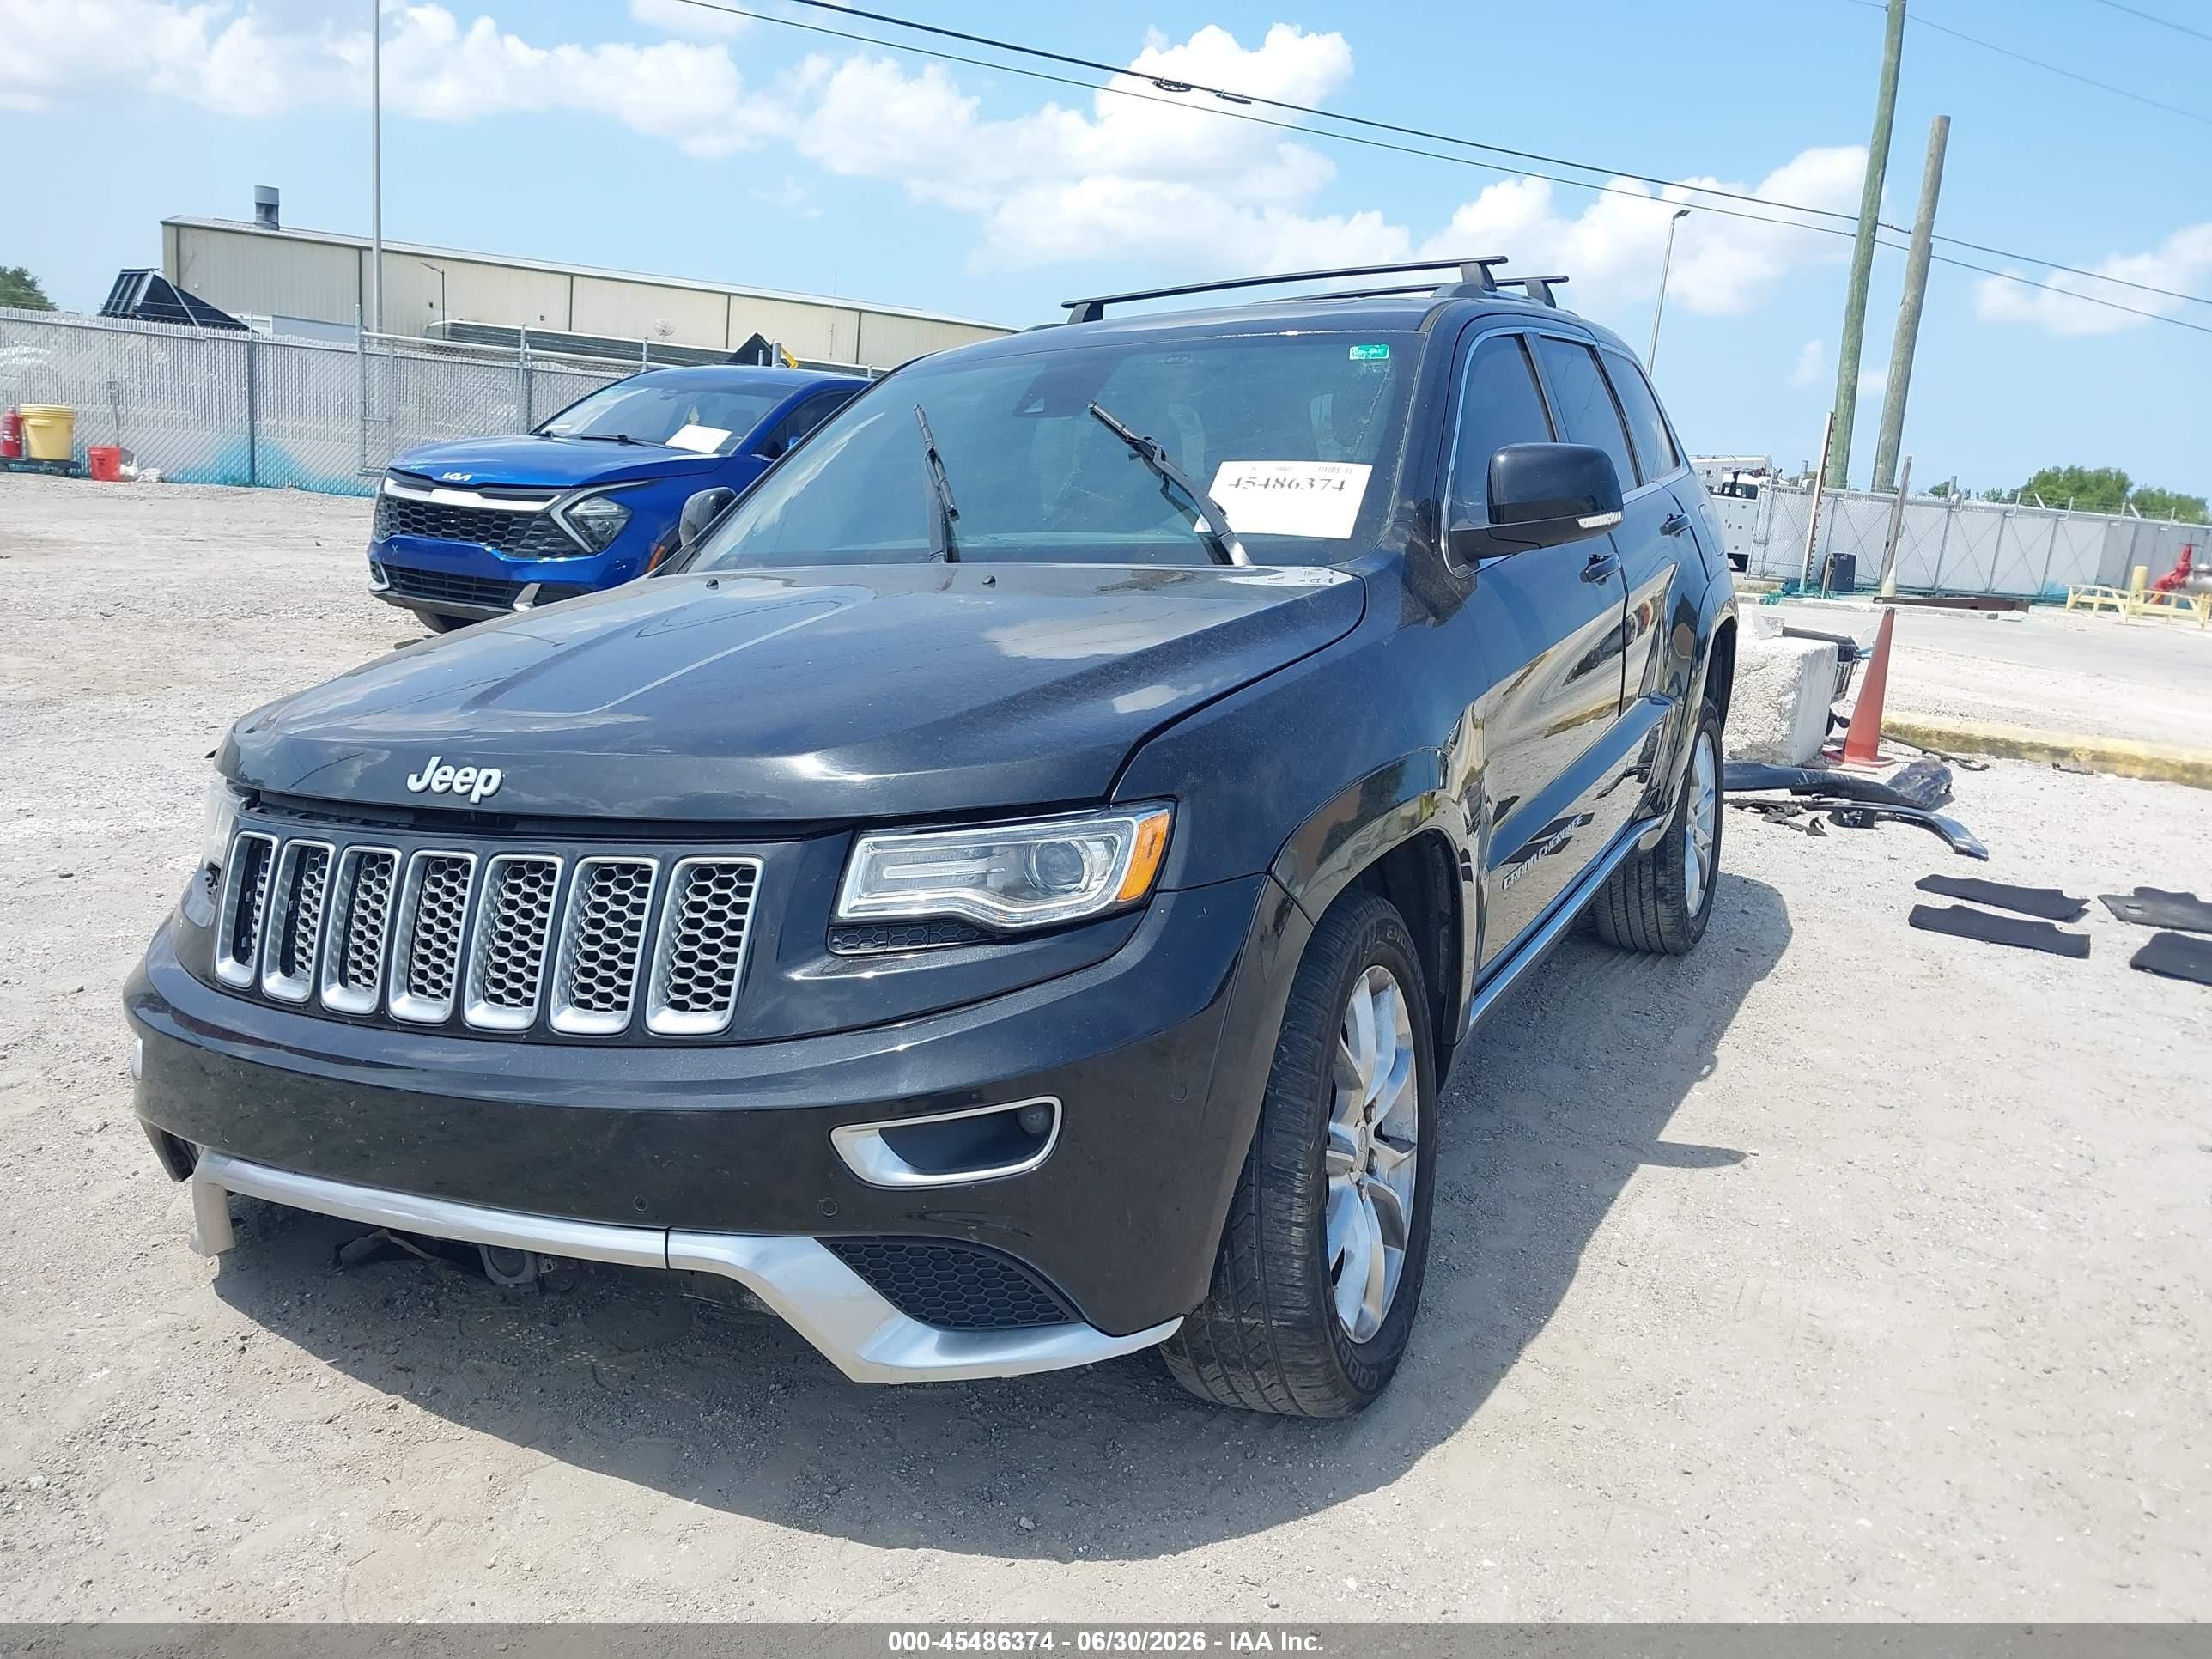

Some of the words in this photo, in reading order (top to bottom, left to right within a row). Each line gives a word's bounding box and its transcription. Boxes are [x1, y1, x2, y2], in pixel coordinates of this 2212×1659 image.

[442, 472, 472, 481] KIA
[1229, 477, 1345, 491] 45486374
[407, 756, 503, 804] Jeep
[1504, 854, 1538, 890] GRAND
[1539, 813, 1583, 857] CHEROKEE
